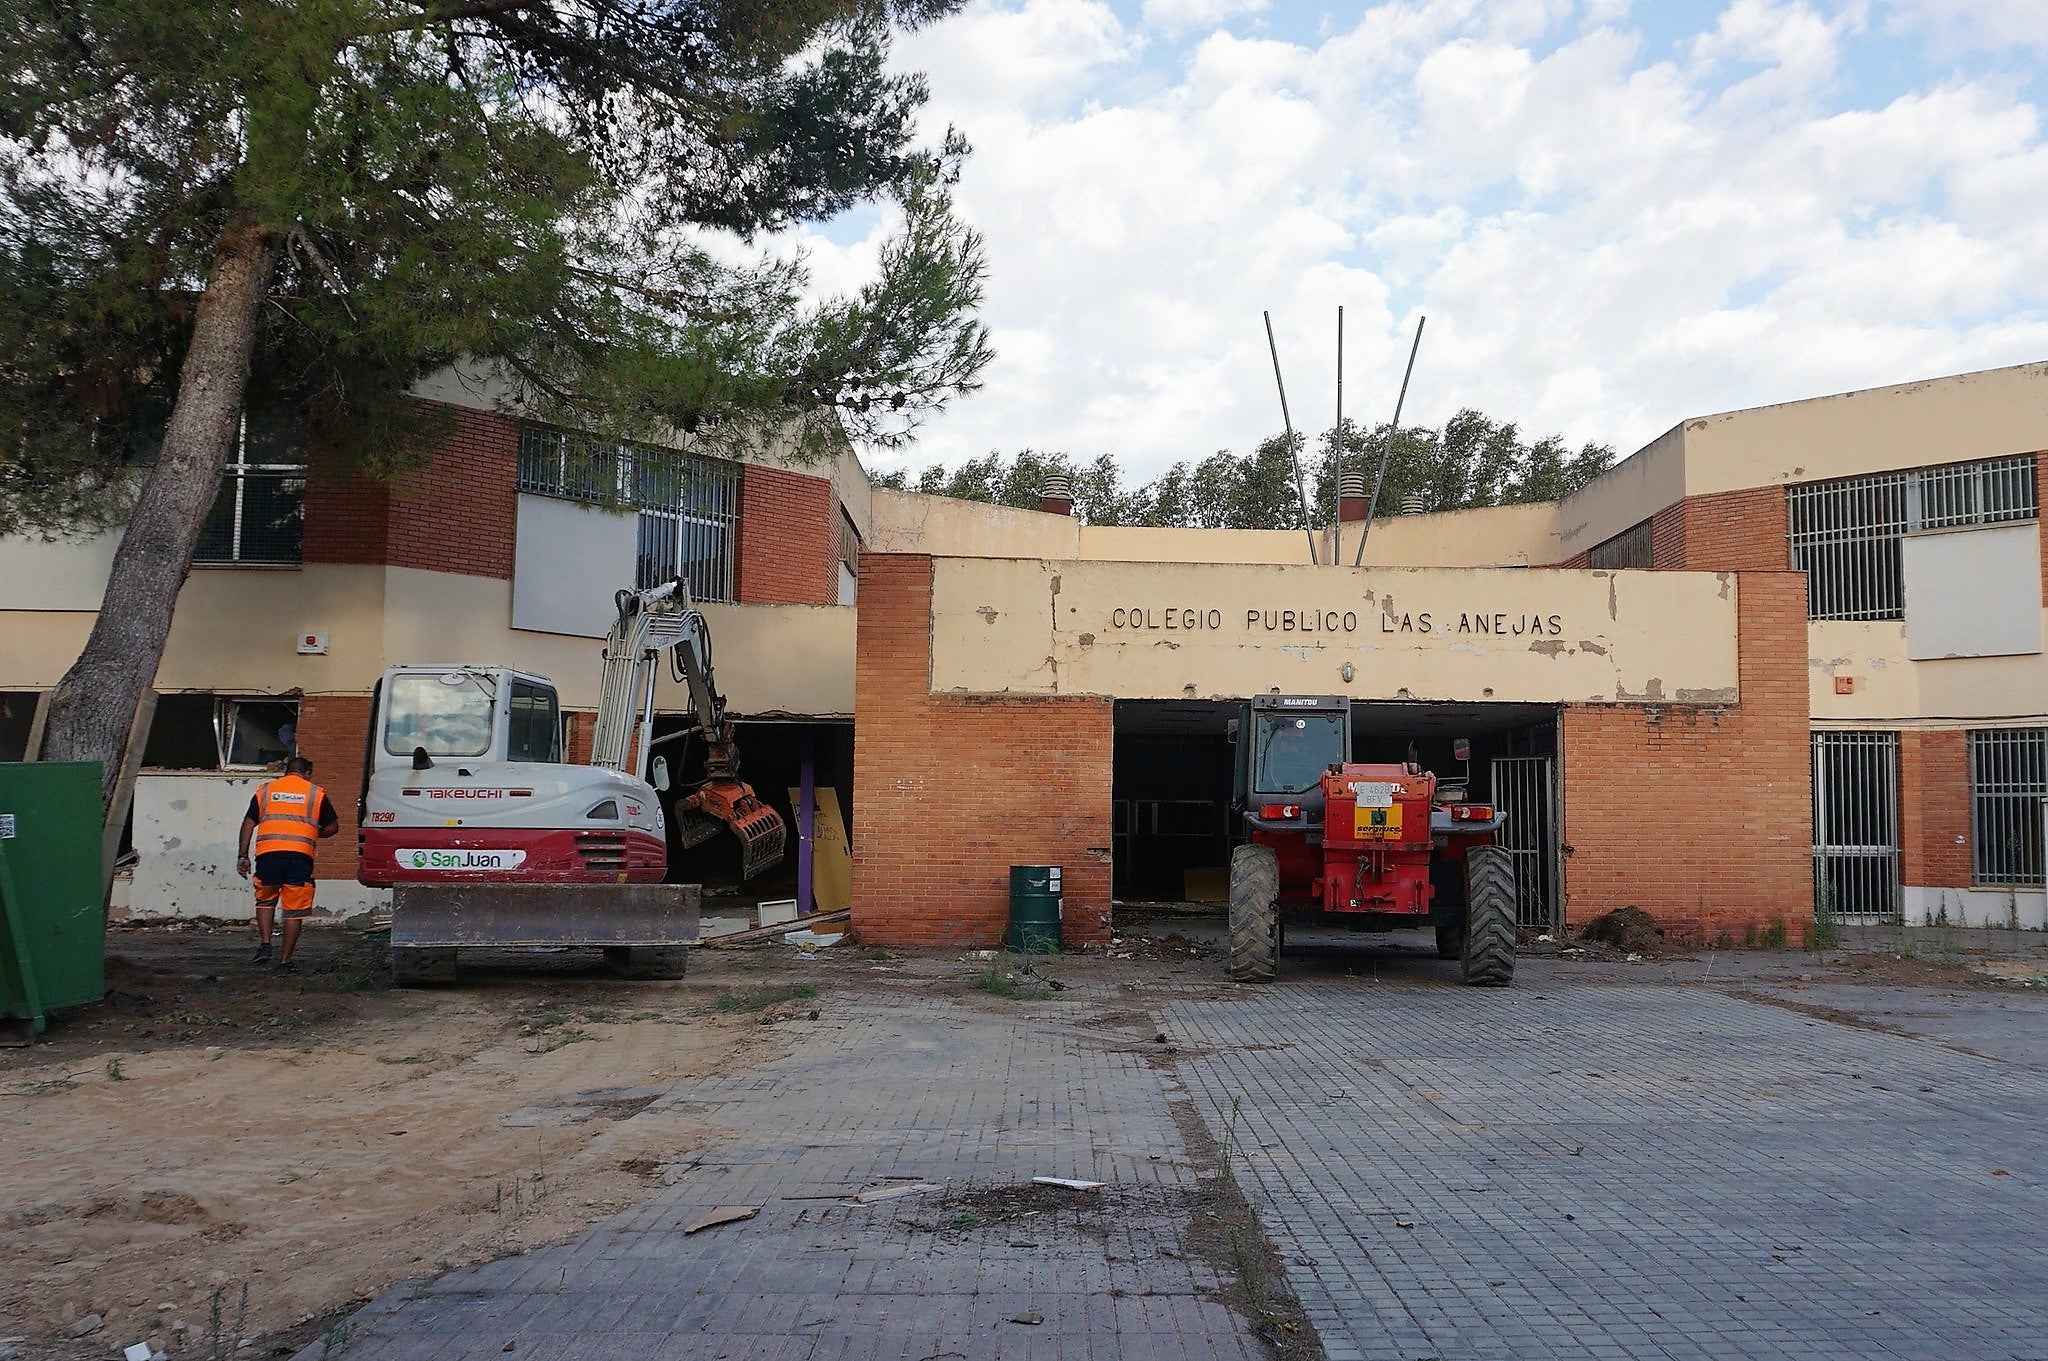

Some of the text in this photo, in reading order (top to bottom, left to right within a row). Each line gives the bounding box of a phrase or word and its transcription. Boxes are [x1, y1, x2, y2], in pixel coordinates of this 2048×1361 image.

[1112, 607, 1562, 636] COLEGIO PUBLICO LAS ANEJAS
[1283, 698, 1318, 706] MANITOU
[426, 789, 502, 799] TAKEUCHI
[371, 812, 395, 822] TB290
